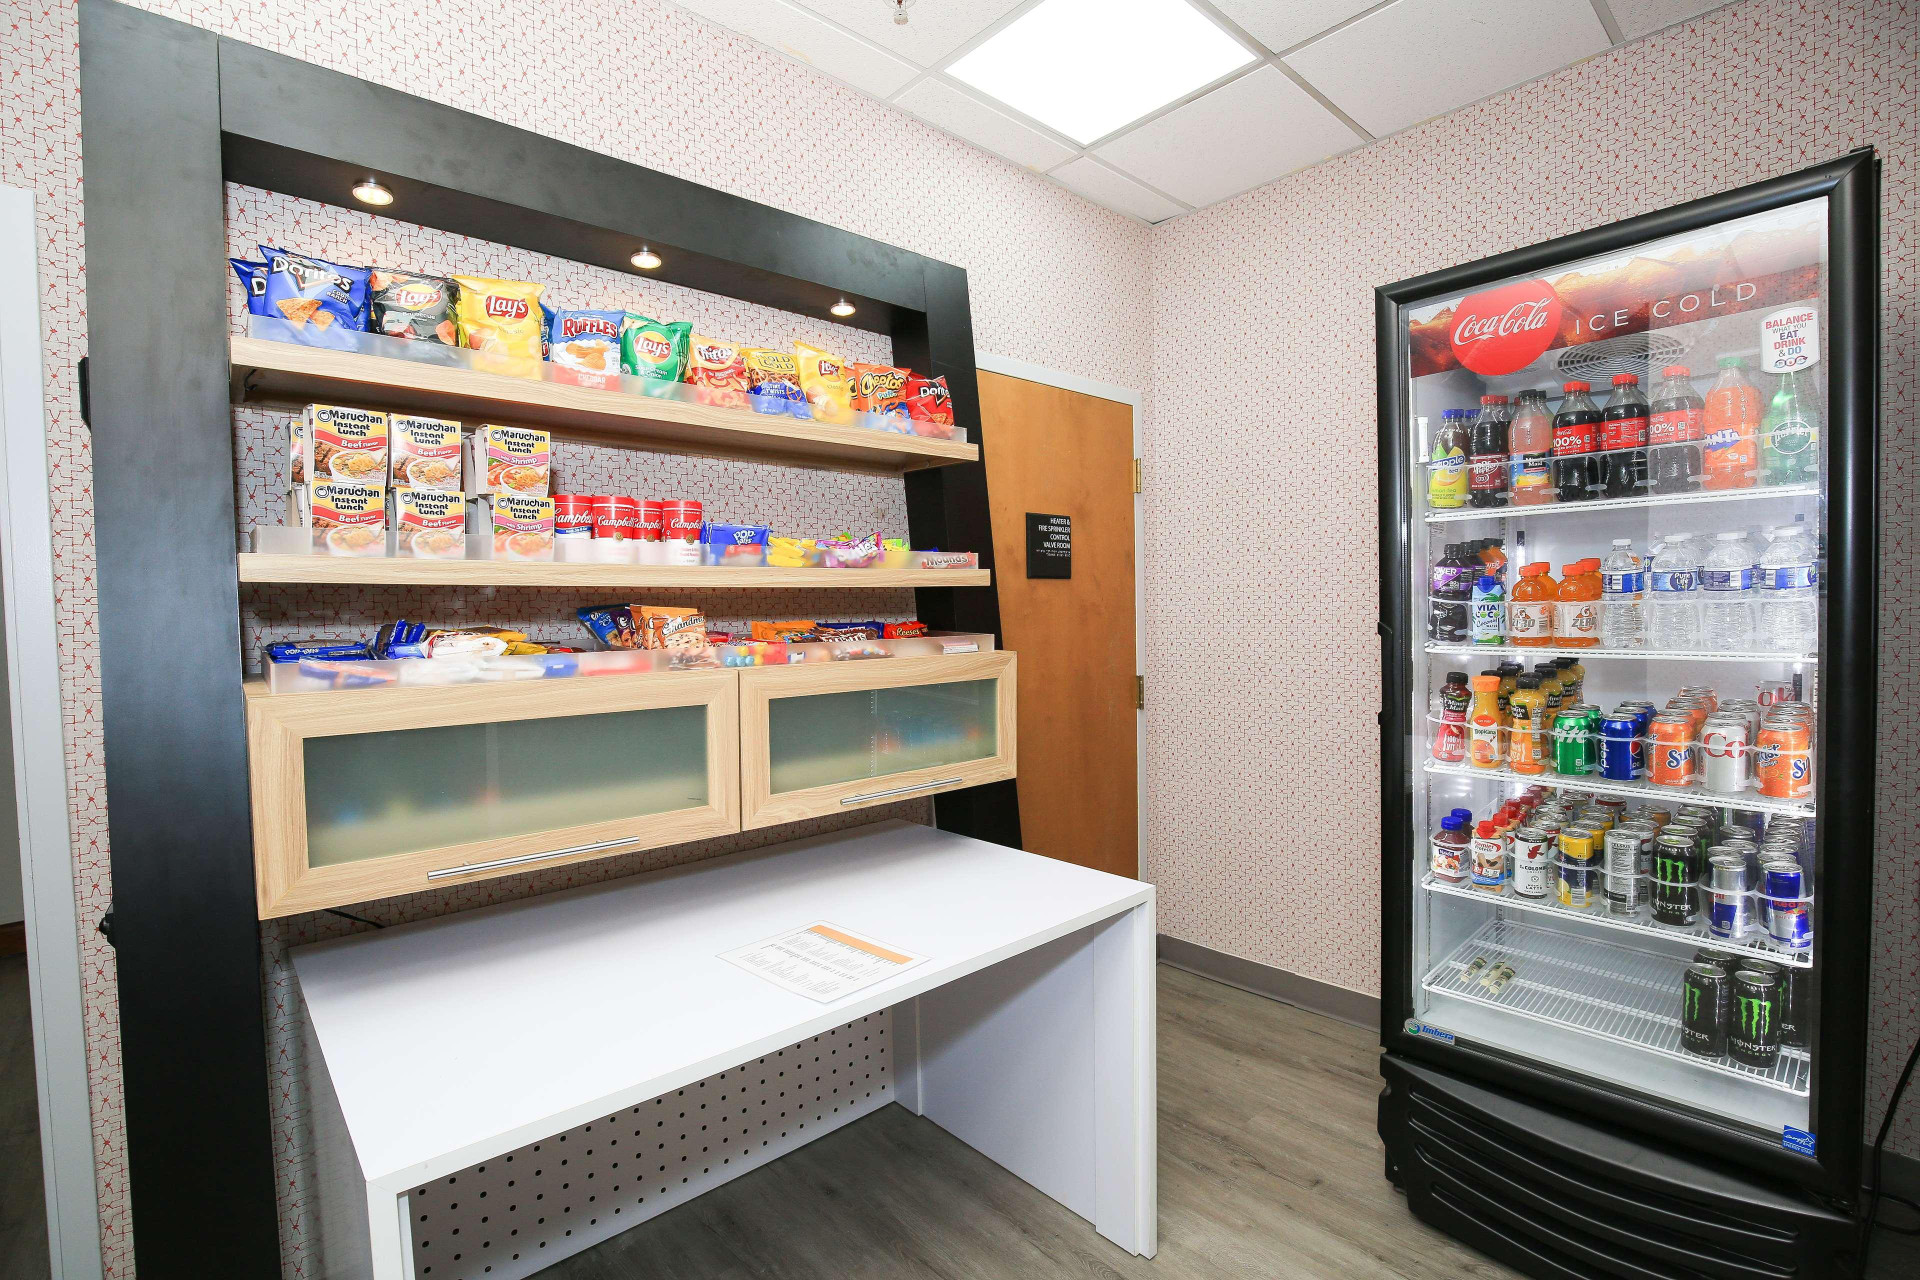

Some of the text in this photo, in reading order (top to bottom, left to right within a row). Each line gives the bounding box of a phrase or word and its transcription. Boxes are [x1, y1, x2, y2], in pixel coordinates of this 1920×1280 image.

[489, 294, 527, 319] Lay's
[1575, 283, 1756, 335] ICE COLD
[1454, 297, 1553, 345] Coca-Cola
[1765, 312, 1814, 329] BALANCE
[562, 317, 617, 339] RUFFLES
[1793, 322, 1807, 330] YOU
[636, 338, 670, 359] Lay's
[1774, 337, 1806, 350] DRINK
[1779, 346, 1802, 357] & DO
[860, 372, 905, 397] Cheetos
[328, 410, 383, 425] Maruchan
[333, 419, 371, 431] Instant
[406, 420, 456, 433] Maruchan
[337, 428, 367, 437] Lunch
[410, 430, 445, 440] Instant
[500, 430, 546, 443] Maruchan
[341, 440, 363, 450] Beef
[414, 437, 441, 445] Lunch
[504, 438, 535, 448] Instant
[1553, 435, 1582, 448] 100%
[417, 448, 437, 456] Beef
[507, 446, 532, 454] Lunch
[511, 456, 538, 465] Shrimp
[327, 485, 380, 498] Maruchan
[331, 495, 368, 505] Instant
[411, 492, 460, 504] Maruchan
[507, 498, 551, 508] Maruchan
[335, 503, 364, 511] Lunch
[415, 501, 449, 510] Instant
[510, 506, 540, 514] Instant
[419, 508, 446, 516] Lunch
[513, 512, 537, 520] Lunch
[338, 514, 361, 523] Beef
[422, 519, 442, 528] Beef
[516, 522, 543, 531] Shrimp
[926, 554, 969, 566] Mounds
[1422, 1025, 1454, 1041] Imbera
